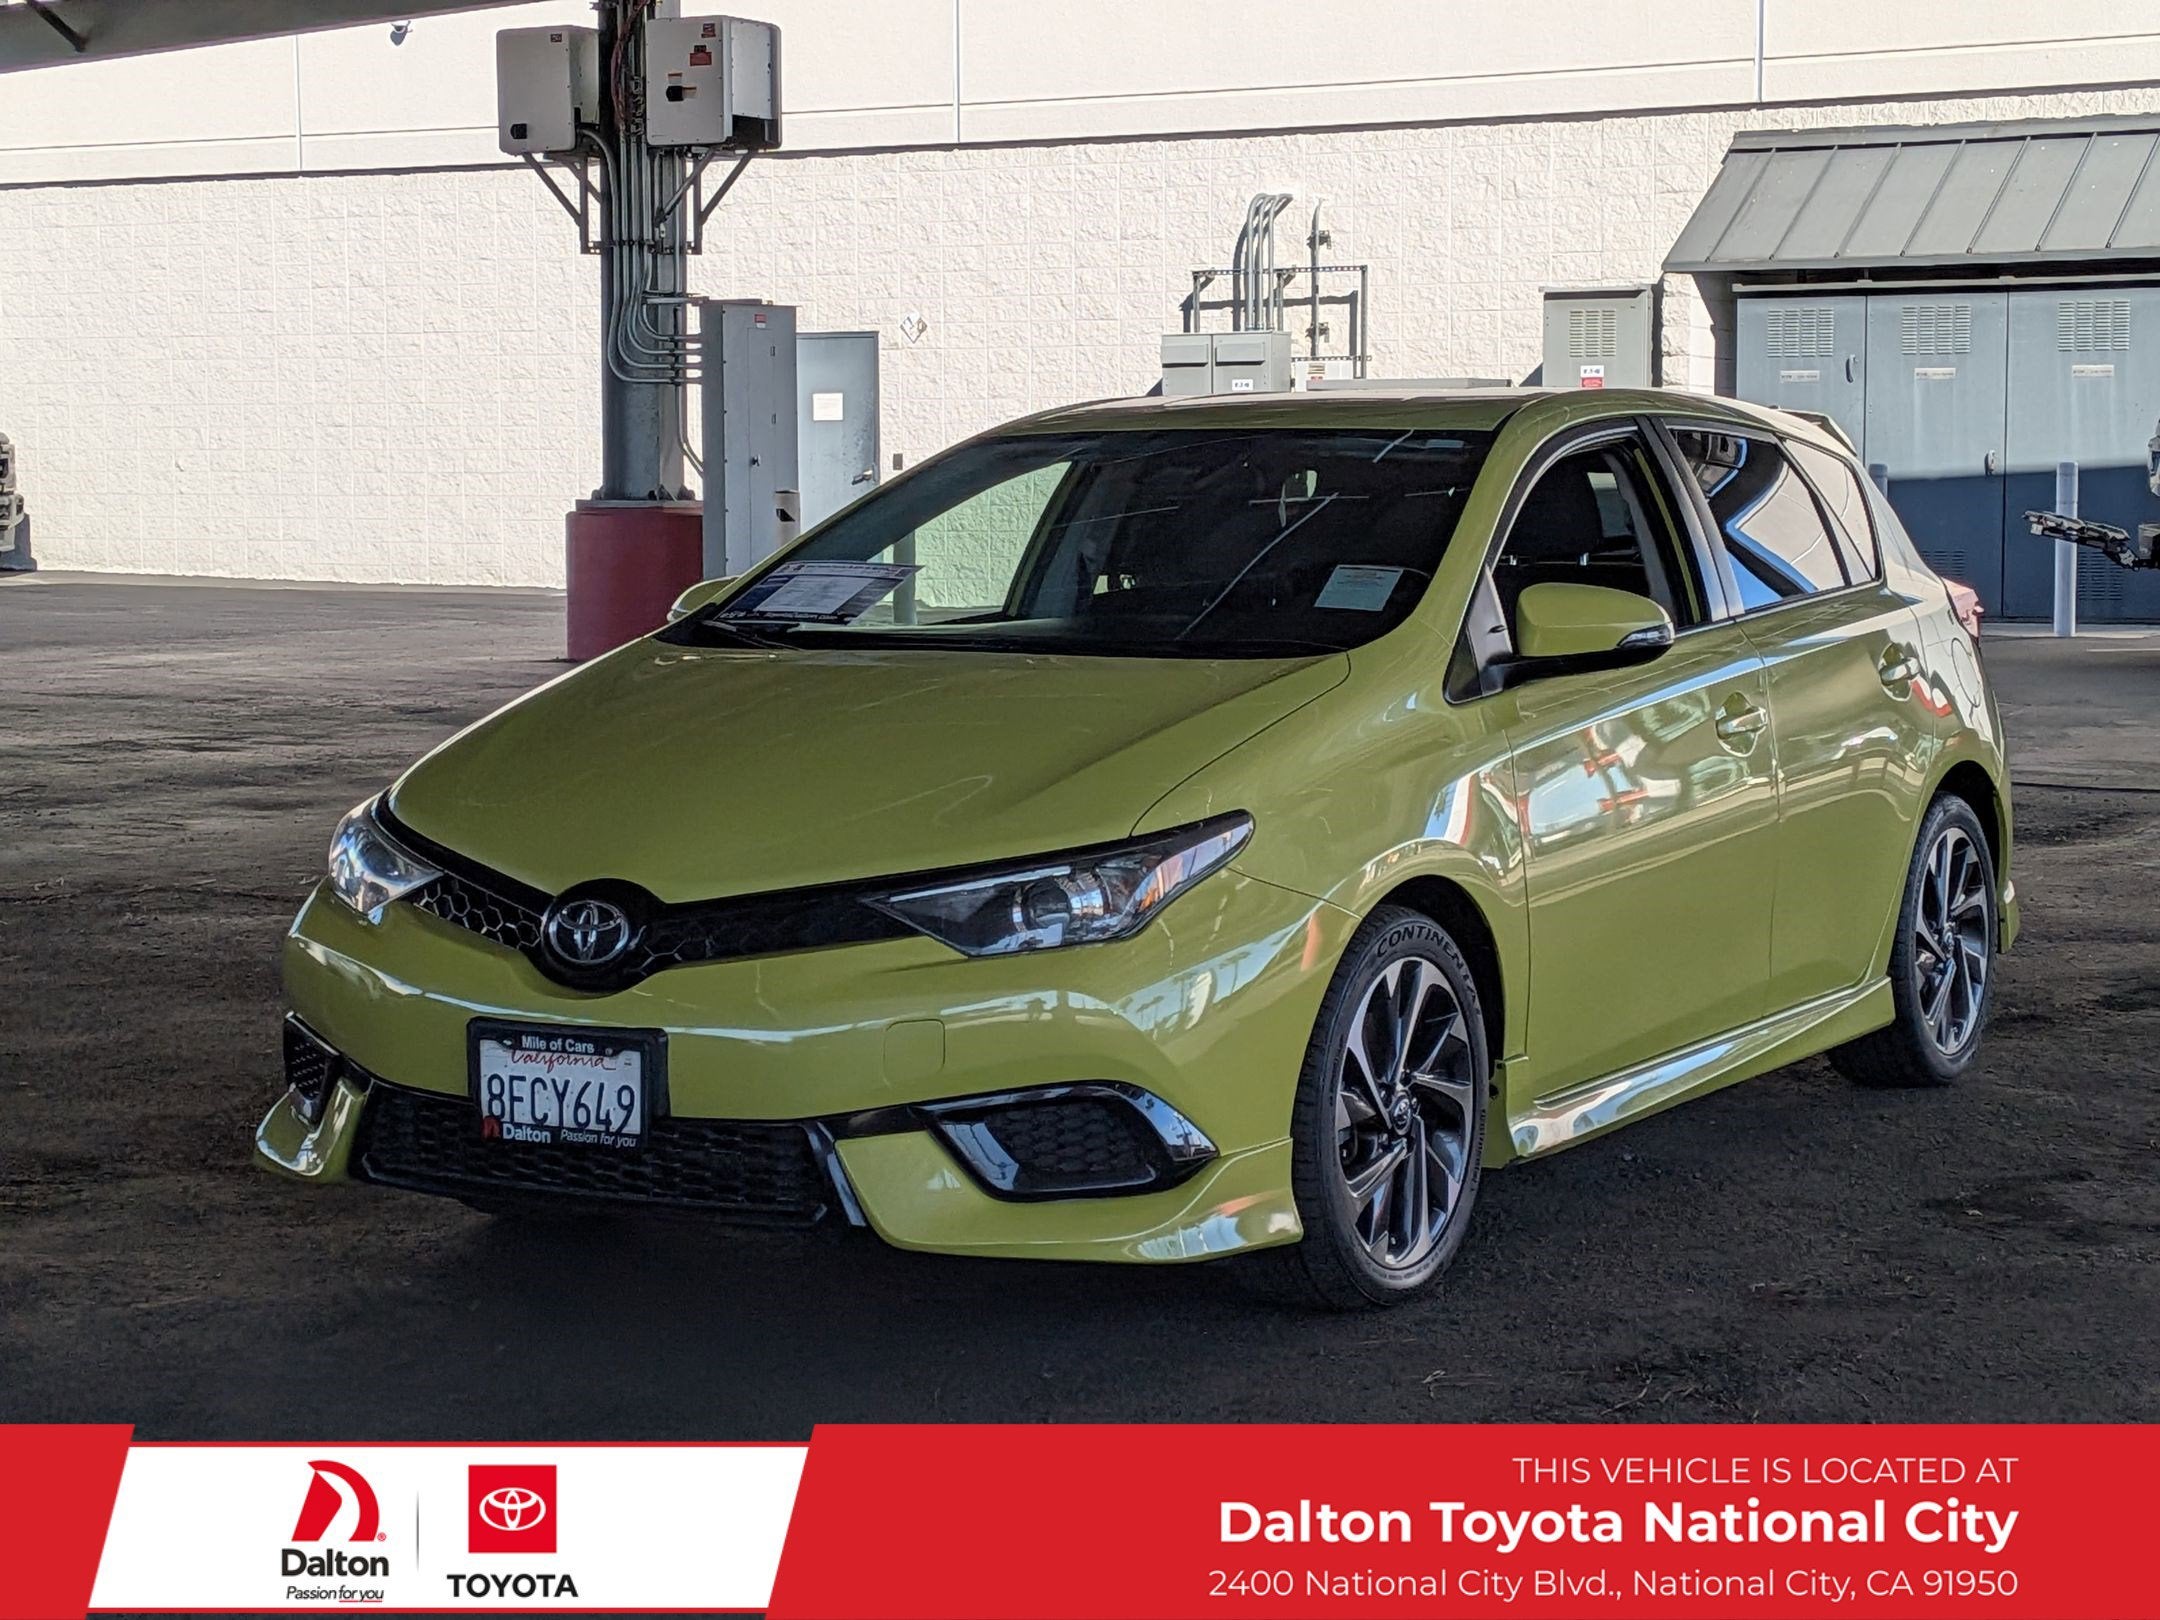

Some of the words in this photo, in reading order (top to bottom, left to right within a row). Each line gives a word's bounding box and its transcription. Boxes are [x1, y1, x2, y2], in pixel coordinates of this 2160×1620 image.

[521, 1035, 546, 1050] Mile
[549, 1038, 562, 1051] of
[565, 1039, 595, 1053] Cars
[502, 1124, 551, 1144] Dalton
[560, 1129, 598, 1144] Passion
[600, 1132, 616, 1146] for
[615, 1135, 637, 1149] you
